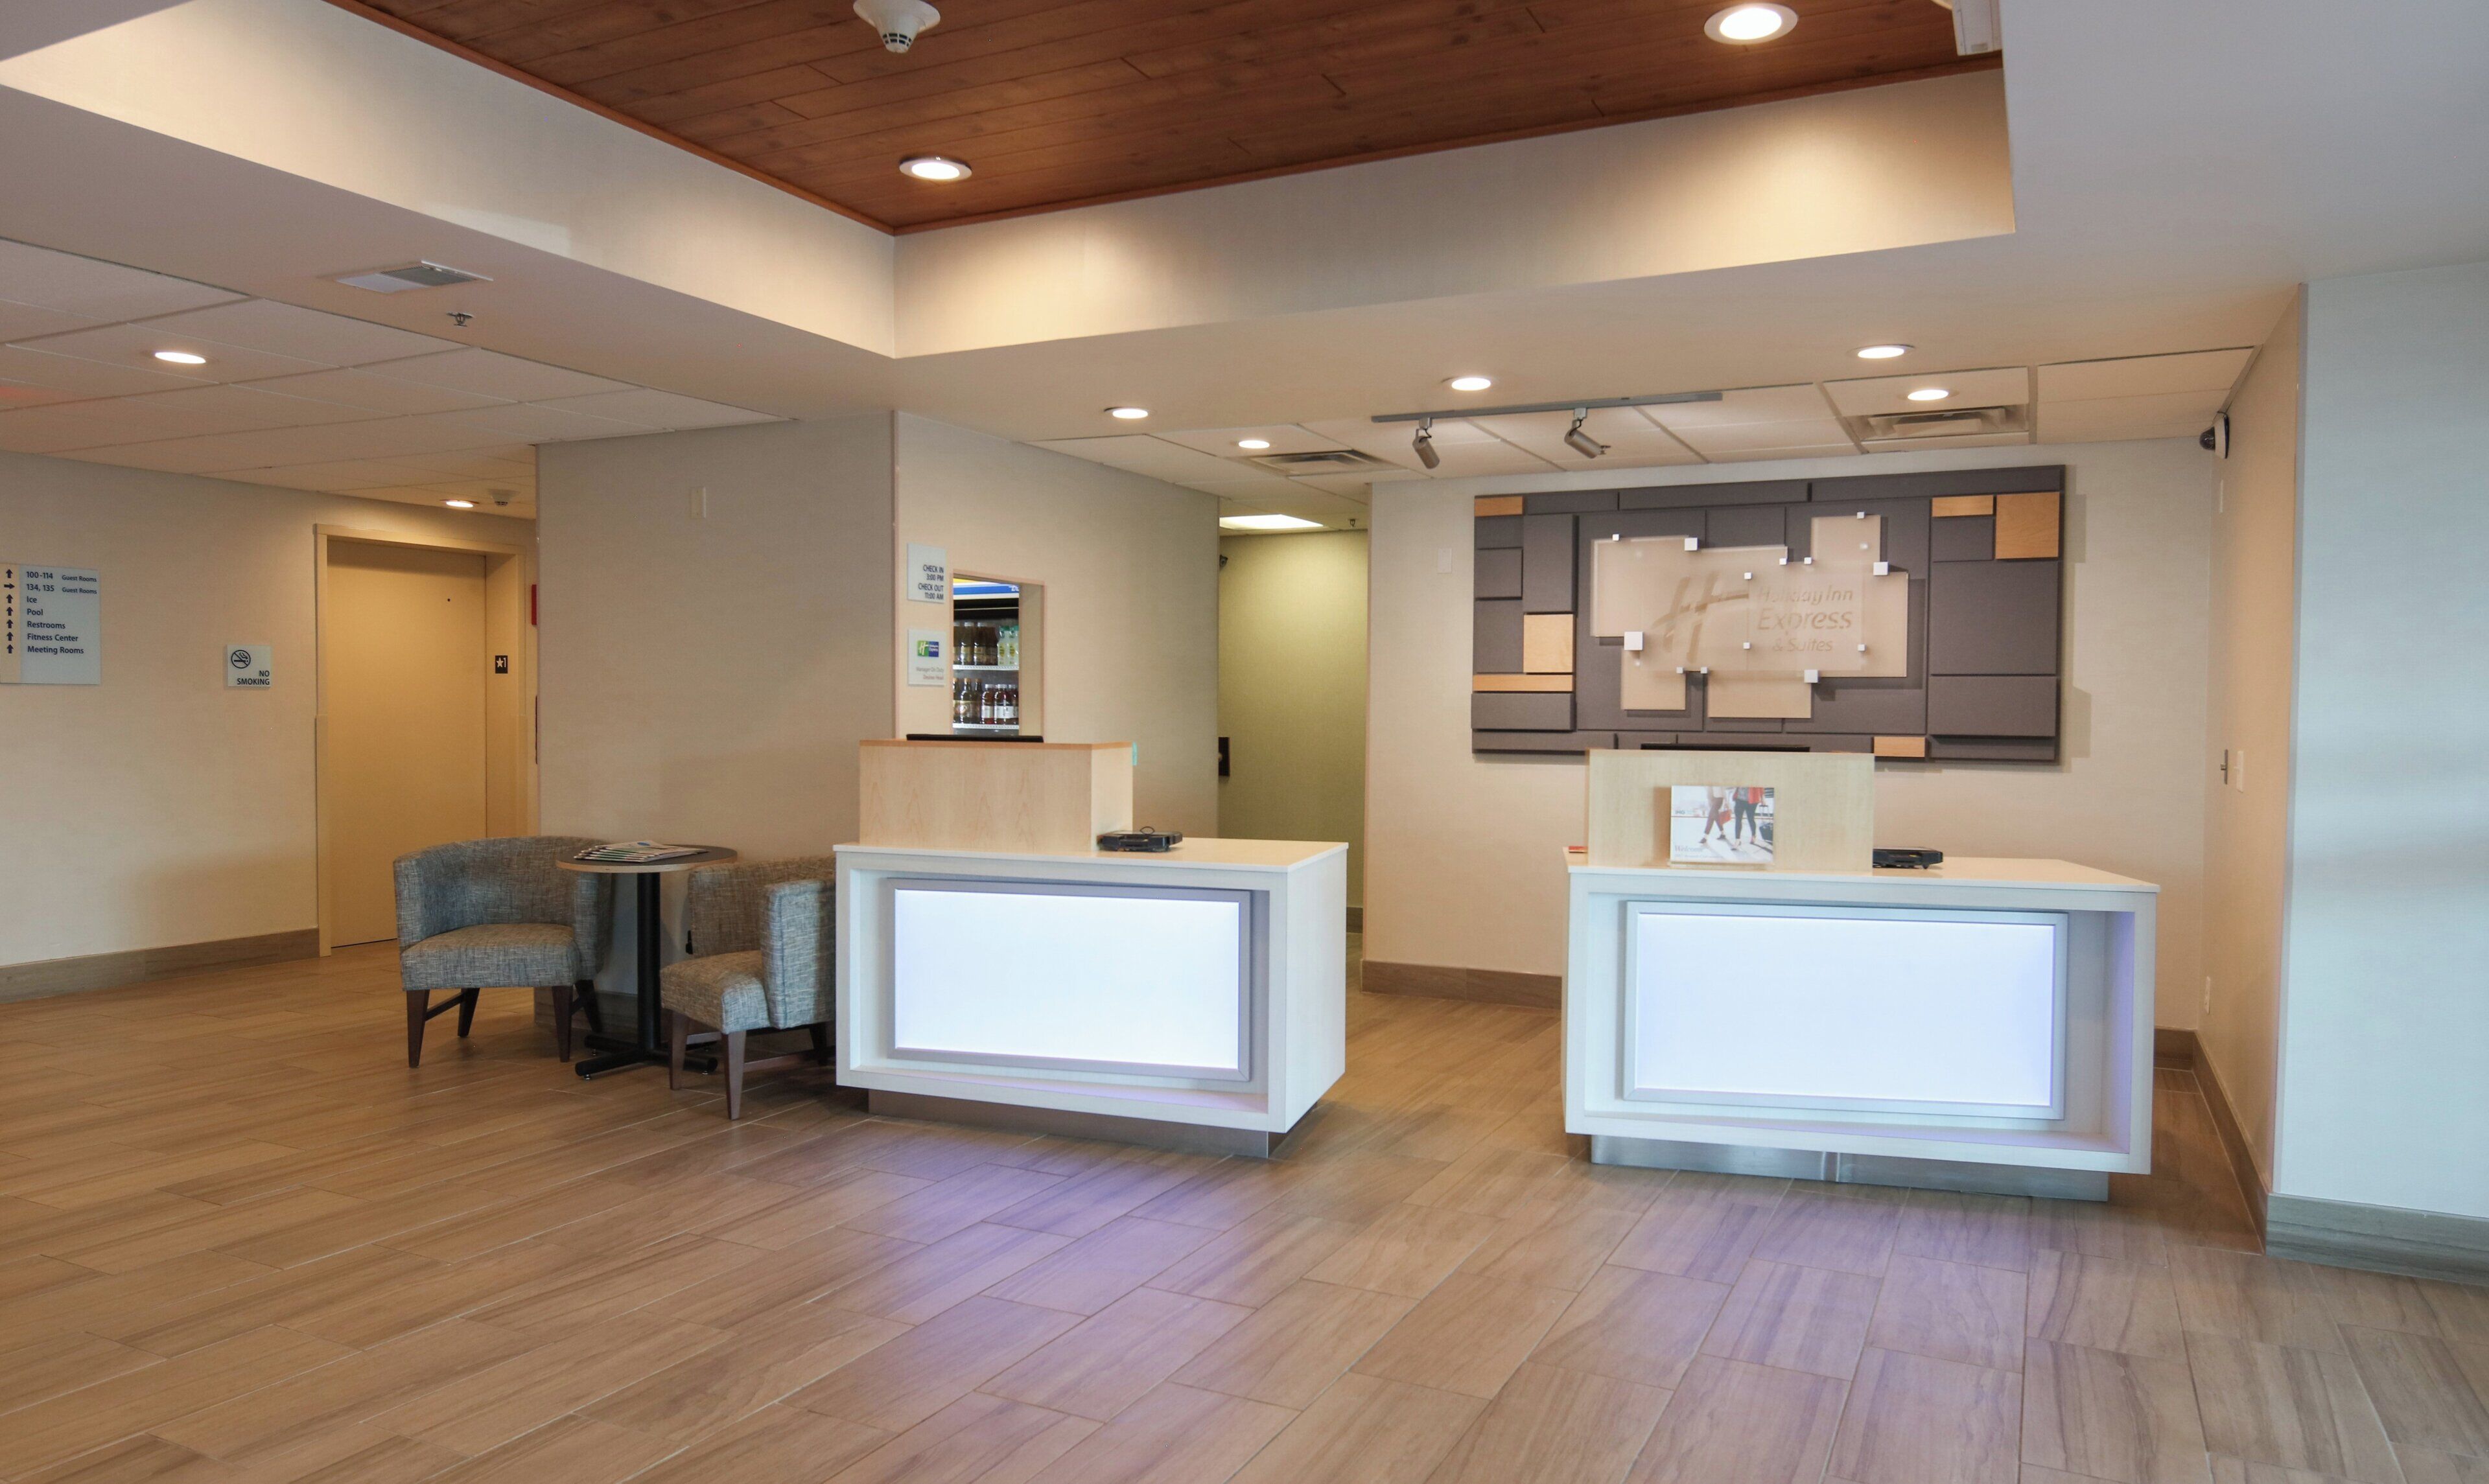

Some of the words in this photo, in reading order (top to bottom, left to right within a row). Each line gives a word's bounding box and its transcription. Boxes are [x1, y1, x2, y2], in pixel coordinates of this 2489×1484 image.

[923, 564, 938, 573] CHECK
[27, 583, 40, 592] 134,
[1757, 585, 1823, 605] Holiday
[1826, 585, 1854, 601] Inn
[27, 621, 66, 629] Restrooms
[1757, 607, 1854, 636] Express
[1772, 638, 1784, 651] &
[1786, 637, 1834, 652] Suites
[27, 645, 58, 655] Meeting
